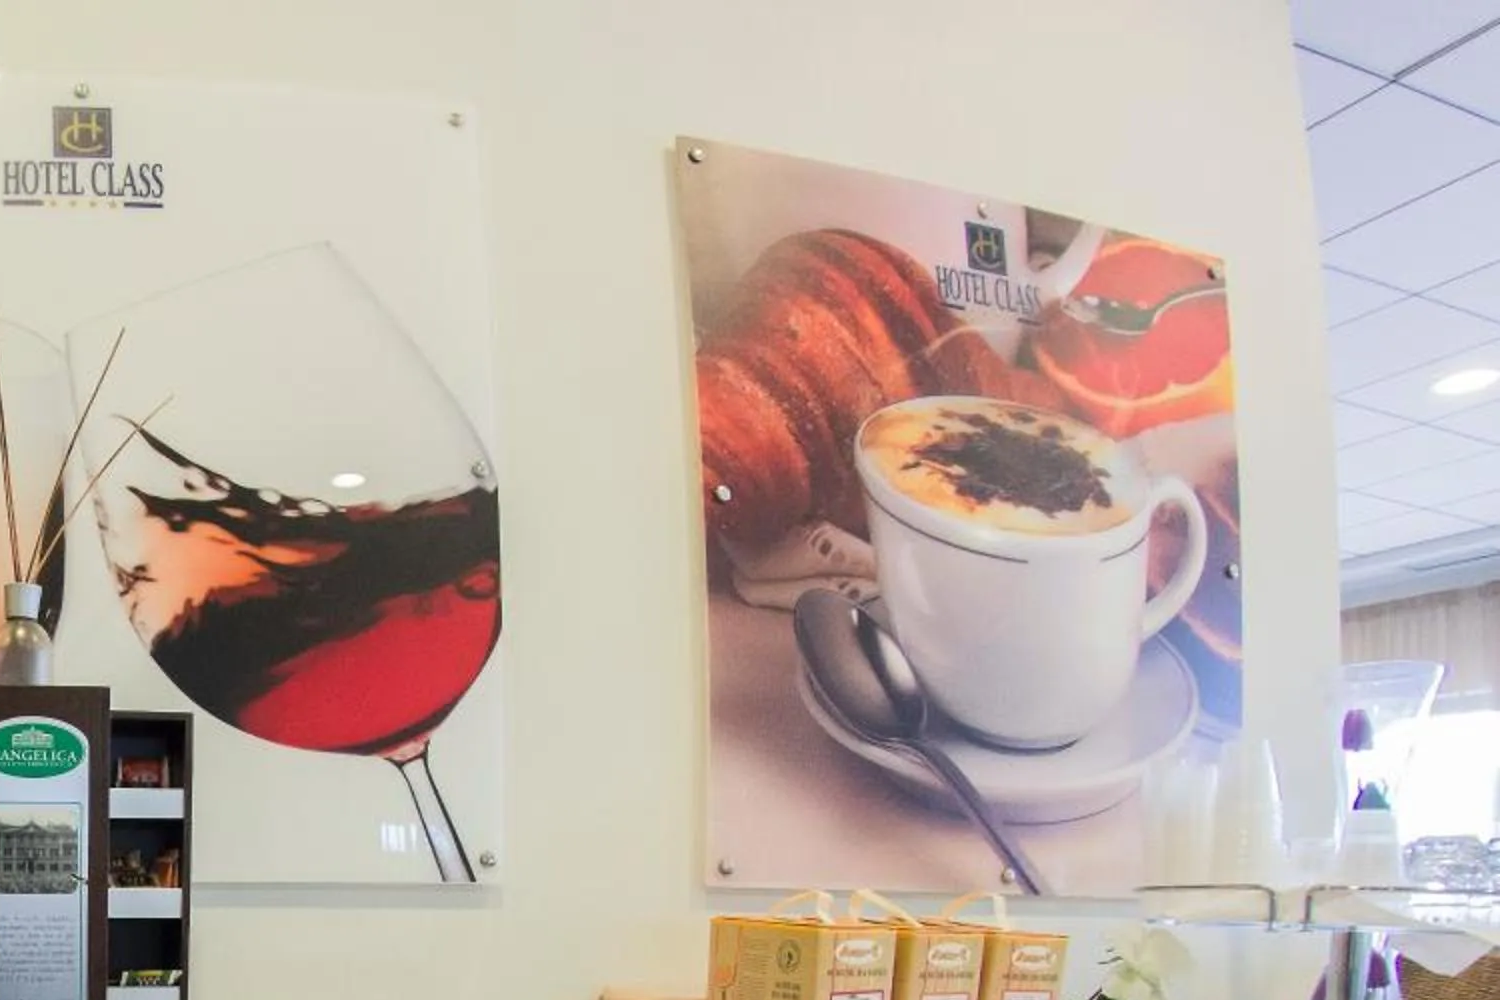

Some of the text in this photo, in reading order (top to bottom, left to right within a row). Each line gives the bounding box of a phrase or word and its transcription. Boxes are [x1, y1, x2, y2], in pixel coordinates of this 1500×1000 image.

[3, 161, 165, 198] HOTEL CLASS
[935, 265, 1043, 314] HOTEL CLASS
